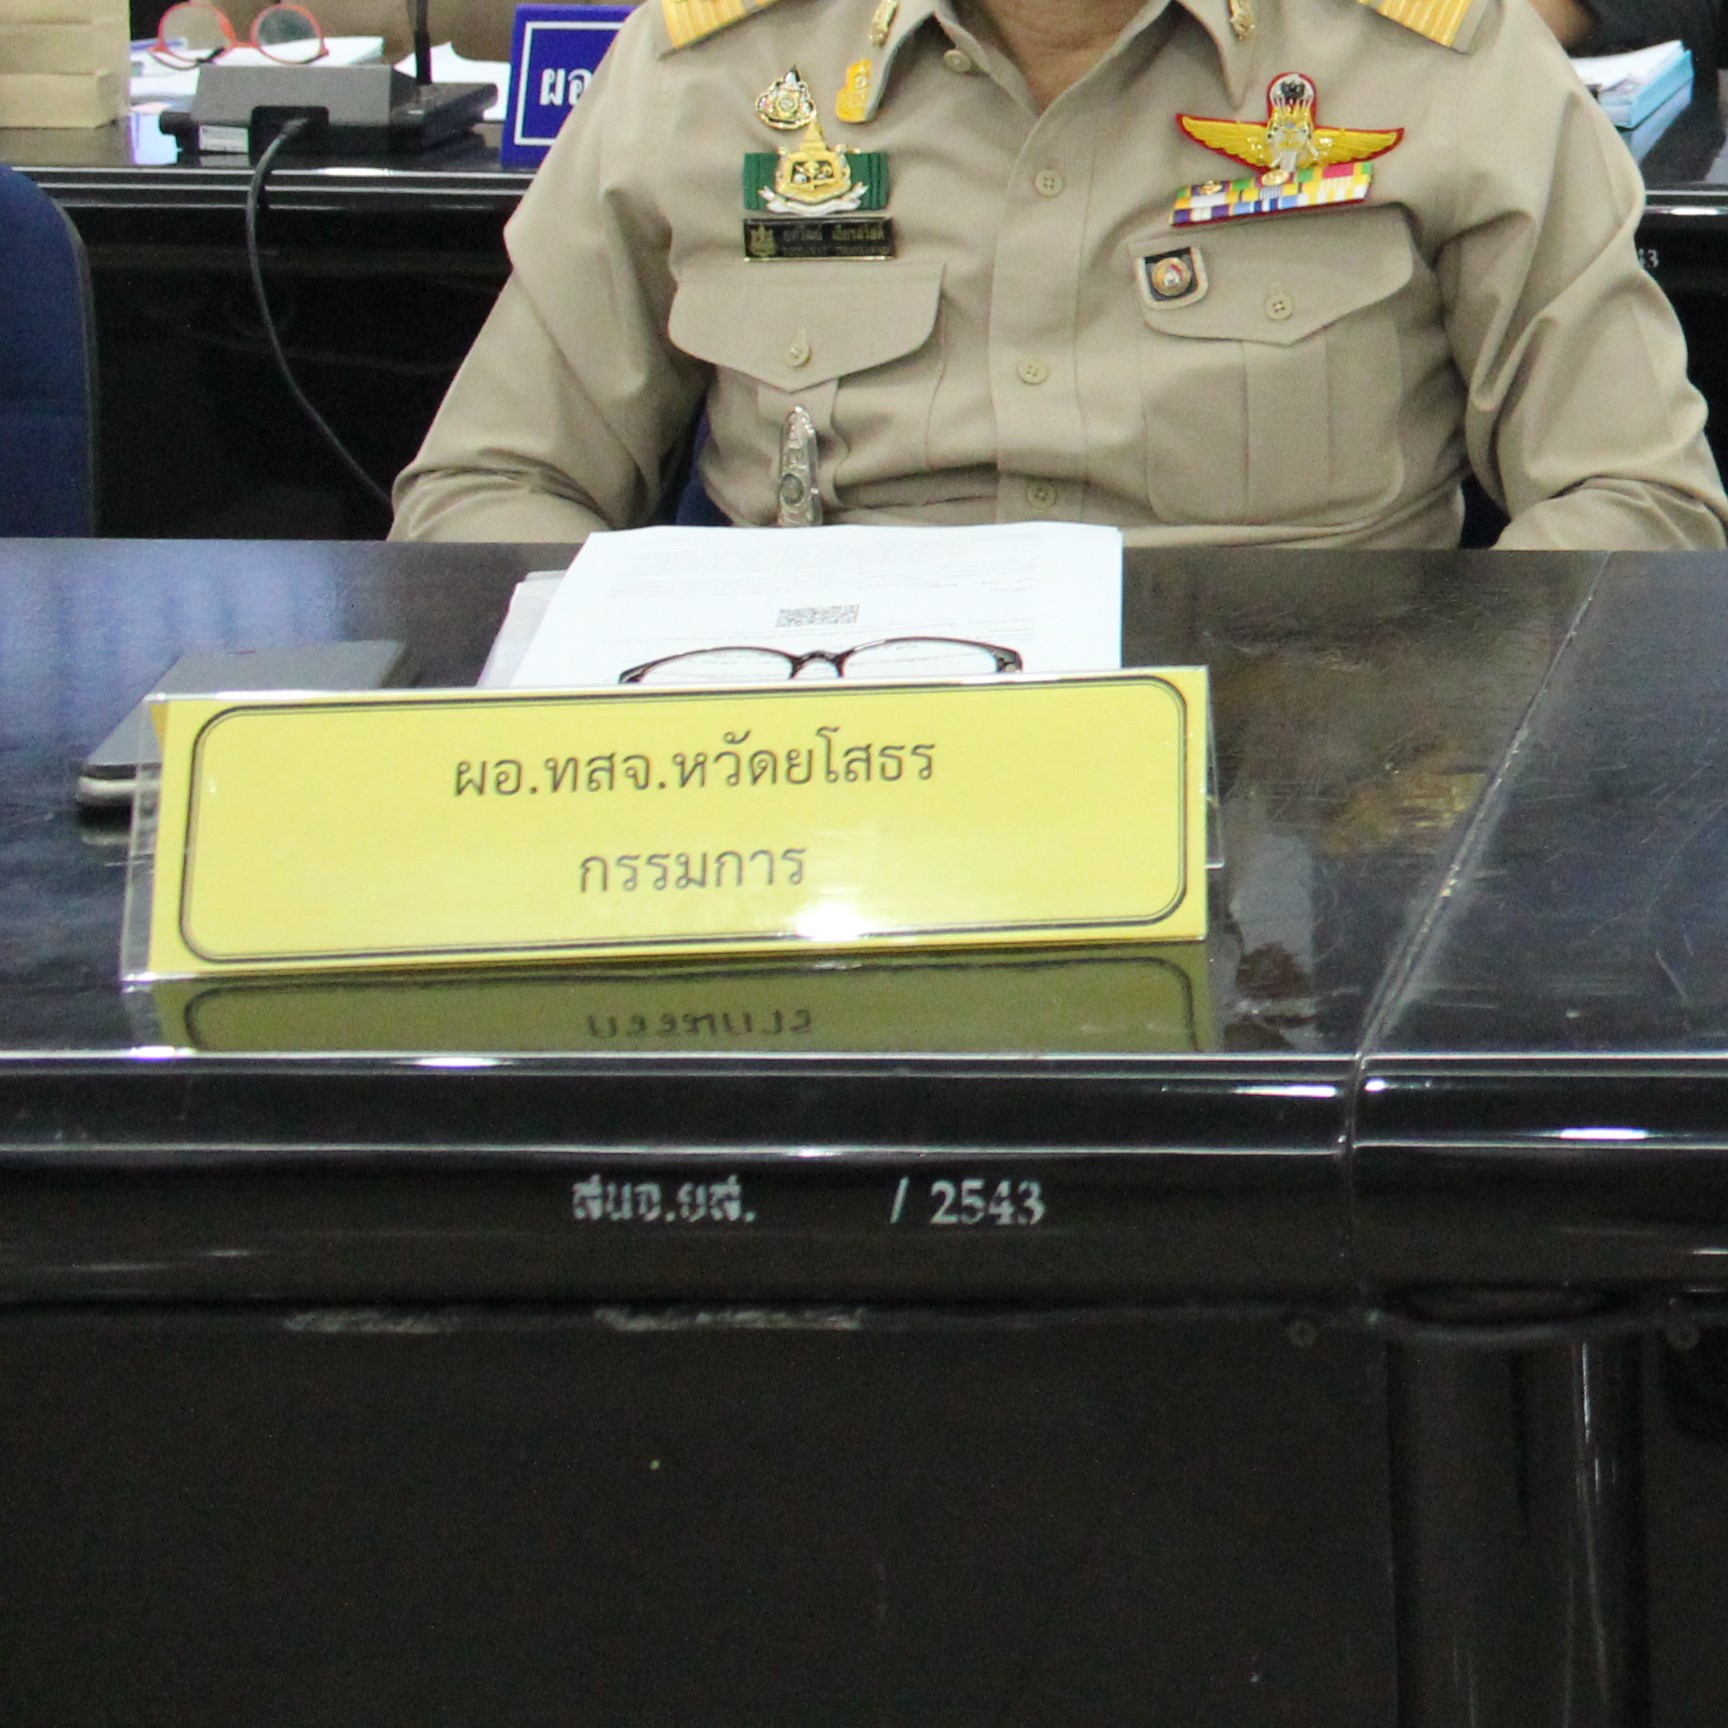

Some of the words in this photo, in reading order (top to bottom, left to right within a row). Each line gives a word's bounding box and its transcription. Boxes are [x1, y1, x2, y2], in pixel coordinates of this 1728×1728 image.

[453, 725, 937, 797] ผอ.ทสจ.หวัดยโสธร
[578, 845, 808, 895] กรรมการ
[929, 1178, 1046, 1225] 2543
